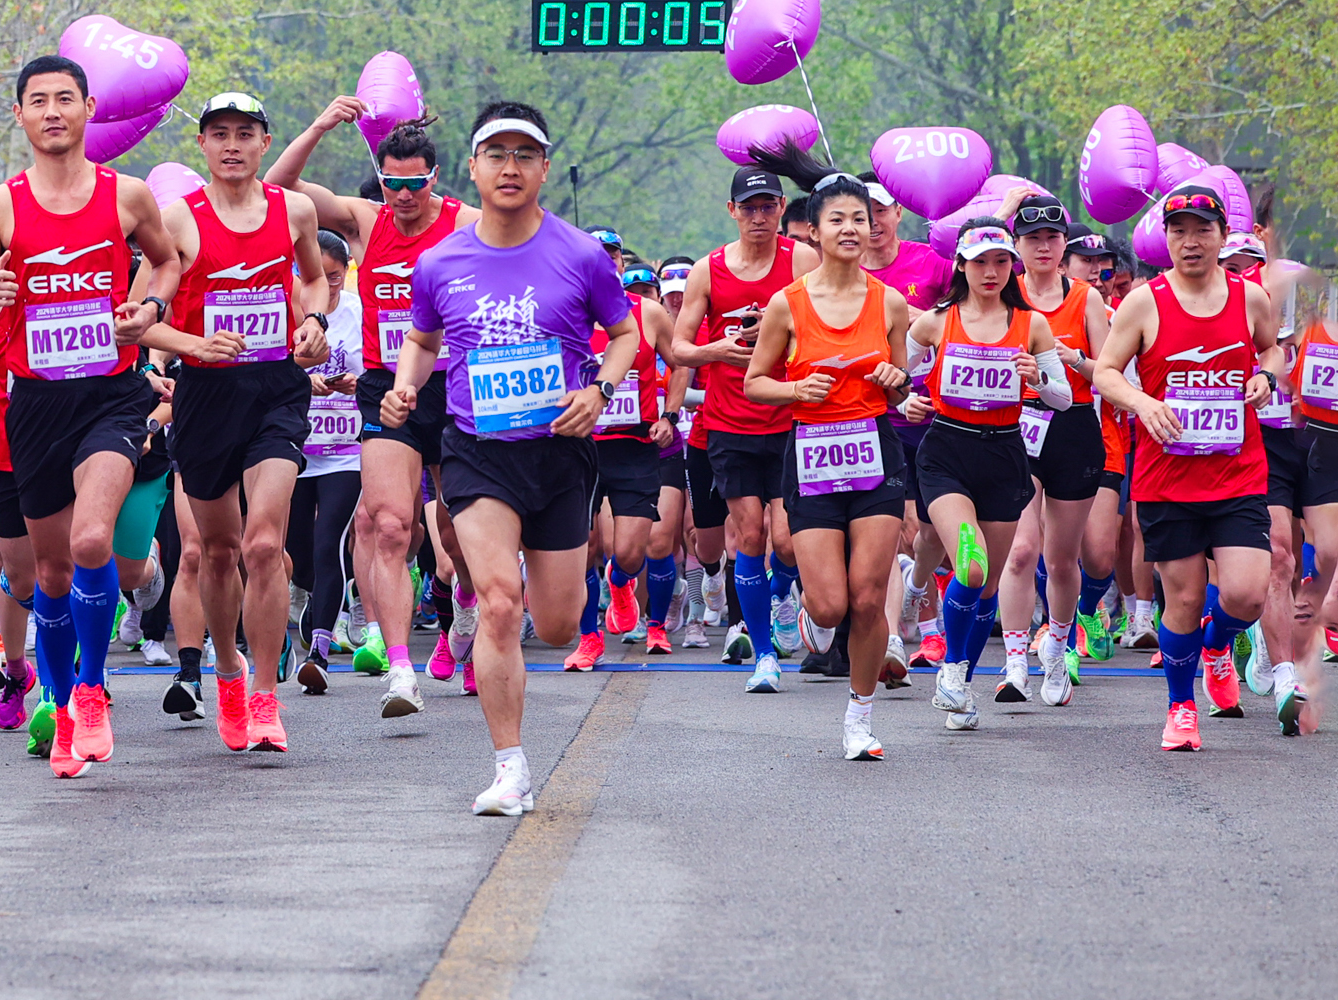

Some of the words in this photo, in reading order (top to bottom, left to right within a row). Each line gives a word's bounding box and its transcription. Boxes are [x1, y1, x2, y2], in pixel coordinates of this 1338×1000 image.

[538, 1, 726, 46] 0:00:05
[83, 22, 164, 70] 1:45
[892, 130, 970, 164] 2:00
[27, 271, 113, 294] ERKE
[374, 284, 412, 299] ER
[448, 284, 476, 295] ERKE
[213, 311, 280, 335] M1277
[31, 322, 112, 355] M1280
[472, 364, 562, 401] M3382
[950, 364, 1013, 390] F2102
[1166, 370, 1245, 388] ERKE
[1311, 364, 1338, 387] F2
[602, 397, 635, 416] 270
[1170, 407, 1238, 431] M1275
[802, 440, 875, 470] F2095
